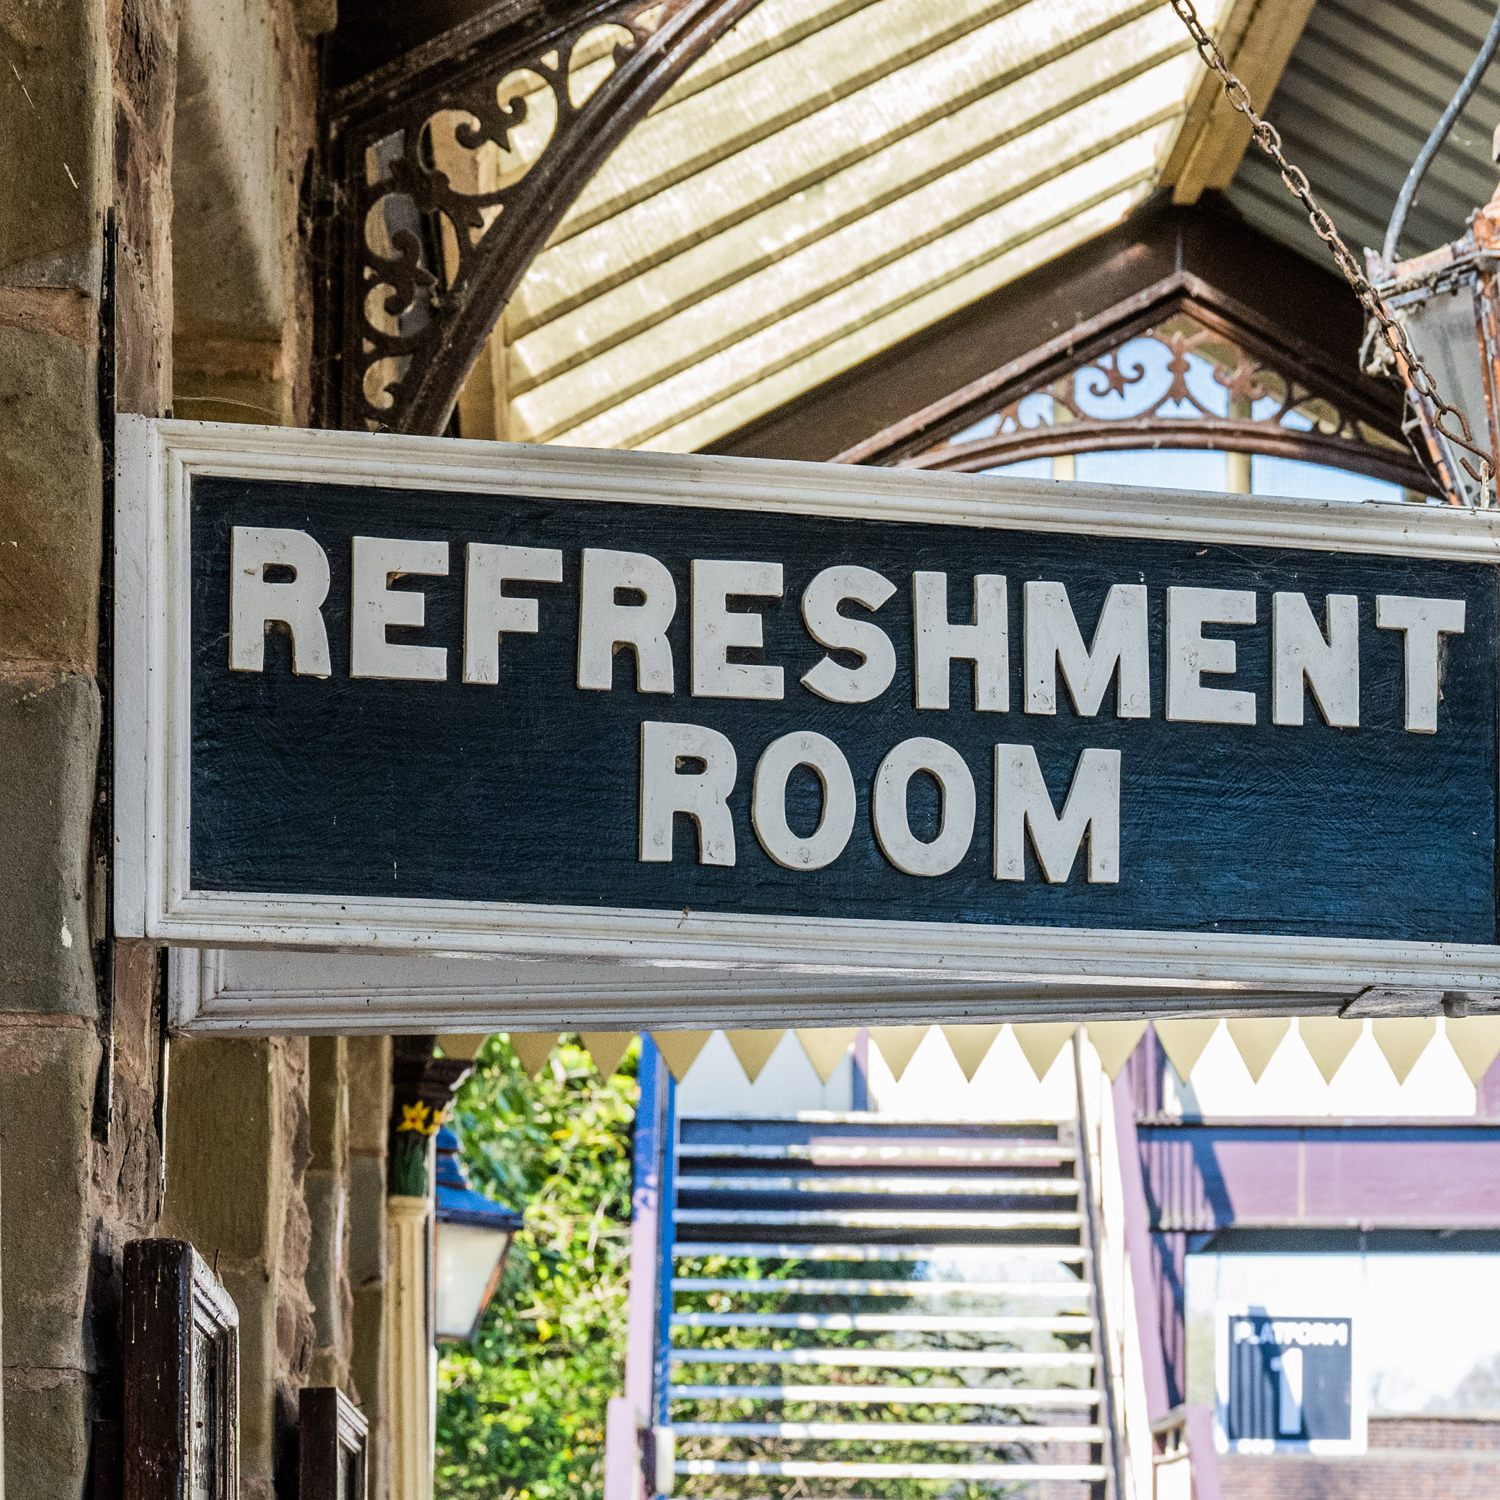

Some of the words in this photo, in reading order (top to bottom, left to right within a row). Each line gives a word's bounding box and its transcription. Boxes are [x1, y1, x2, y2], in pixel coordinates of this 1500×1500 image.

[226, 523, 1468, 736] REFRESHMENT
[637, 720, 1123, 887] ROOM
[1233, 1321, 1349, 1347] PLATFORM
[1269, 1347, 1304, 1435] 1
